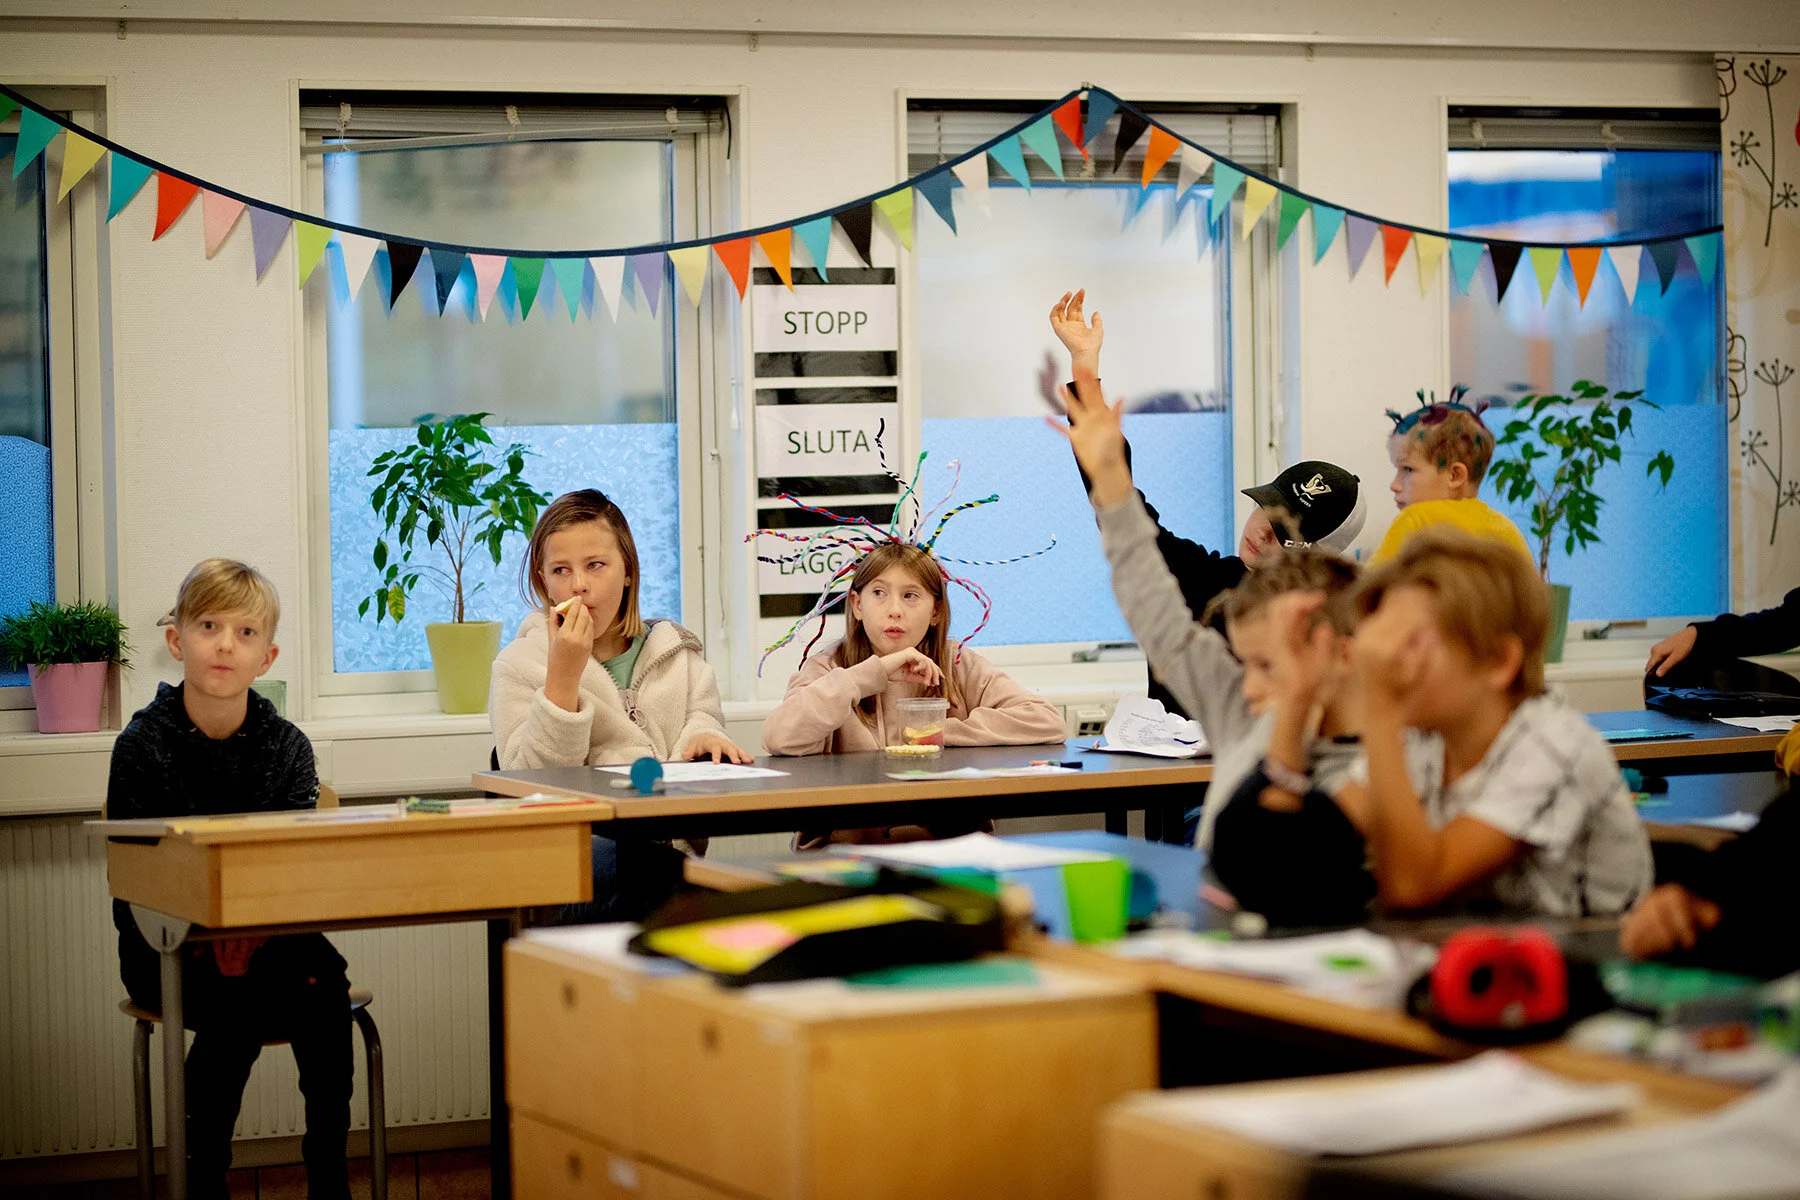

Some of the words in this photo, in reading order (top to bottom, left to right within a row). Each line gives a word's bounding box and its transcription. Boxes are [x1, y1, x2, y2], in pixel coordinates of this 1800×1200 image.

[784, 311, 868, 335] STOPP
[787, 430, 870, 455] SLUTA
[780, 548, 843, 575] LÄGG
